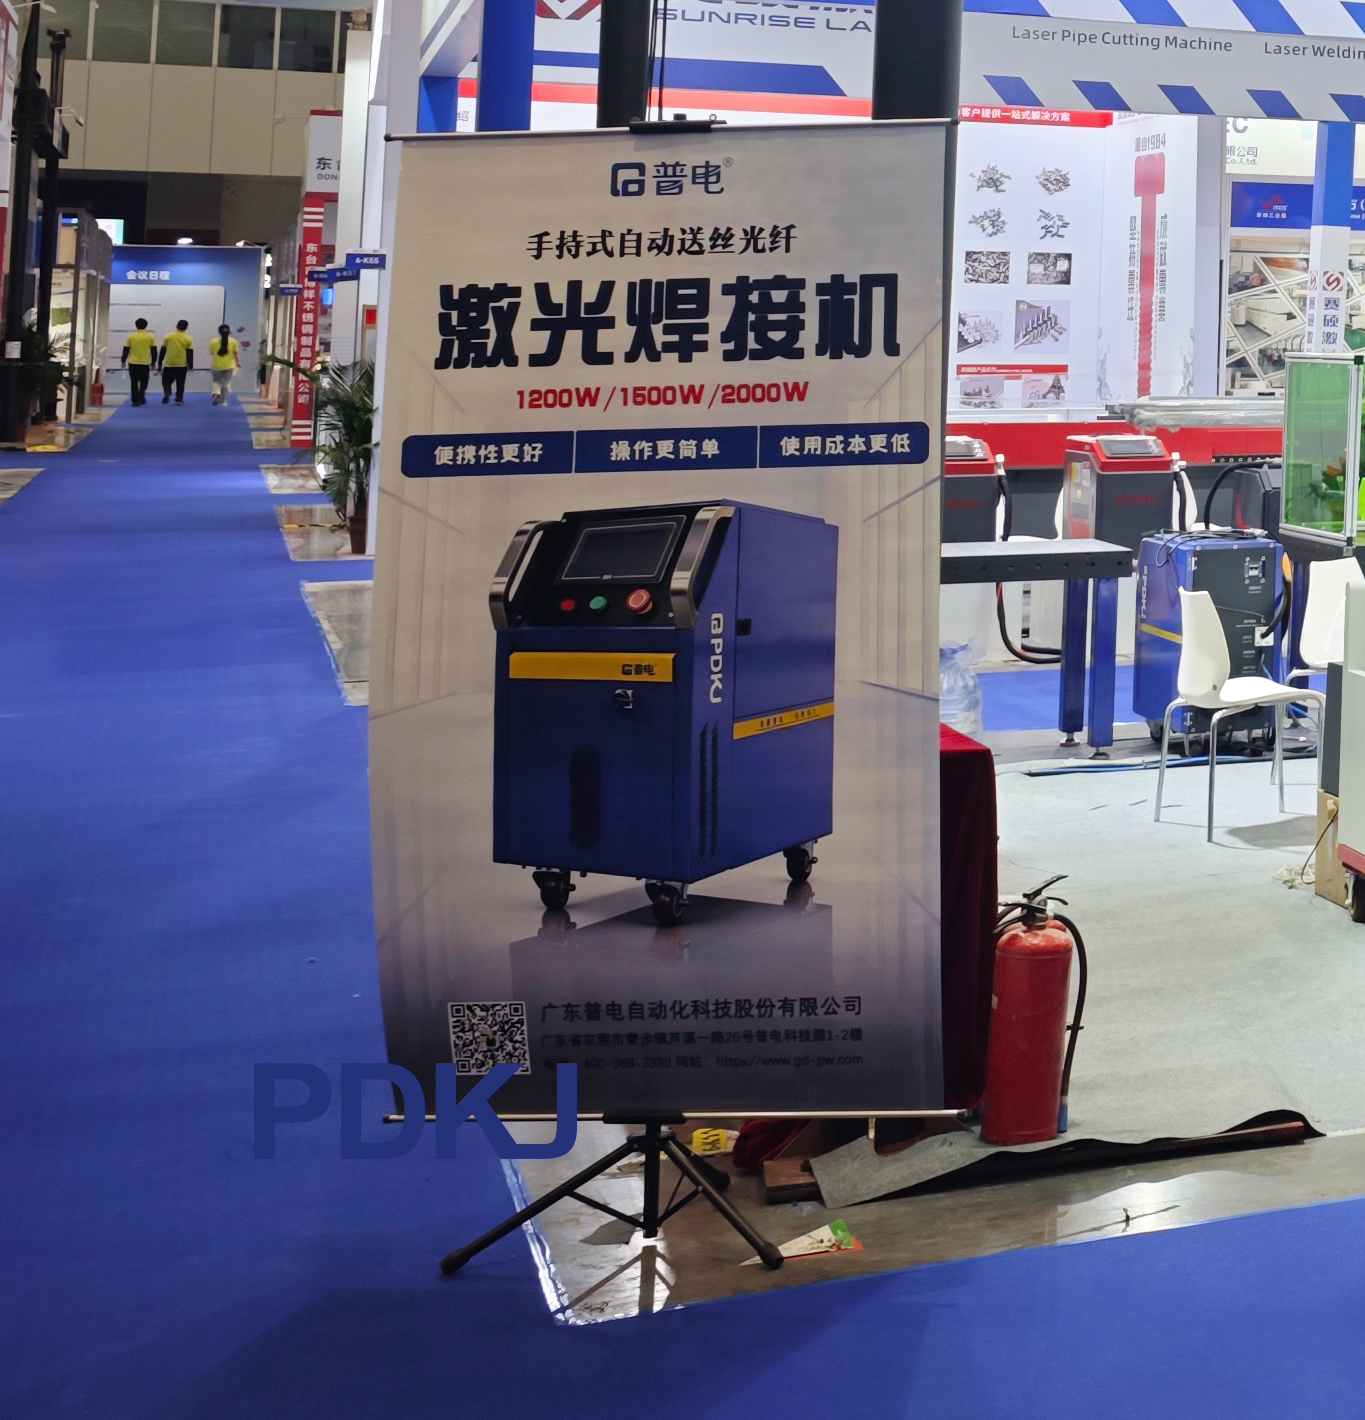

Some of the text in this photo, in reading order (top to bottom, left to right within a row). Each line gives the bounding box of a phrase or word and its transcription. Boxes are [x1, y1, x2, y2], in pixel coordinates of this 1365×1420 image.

[656, 7, 816, 29] SUNRISE
[1011, 26, 1233, 52] Laser Pipe Cutting Machine
[1264, 41, 1308, 57] Laser
[958, 106, 1071, 123] 客户提供一站式解决方案
[317, 173, 340, 181] DON
[526, 223, 798, 260] 手持式自动送丝光纤
[126, 269, 171, 281] 会议日程
[434, 273, 902, 370] 激光焊接机
[434, 443, 544, 467] 便携性更好
[609, 440, 721, 462] 操作更简单
[780, 432, 912, 457] 使用成本更低
[710, 638, 724, 704] PDKJ
[541, 996, 863, 1023] 广东普电自动化科技股份有限公司
